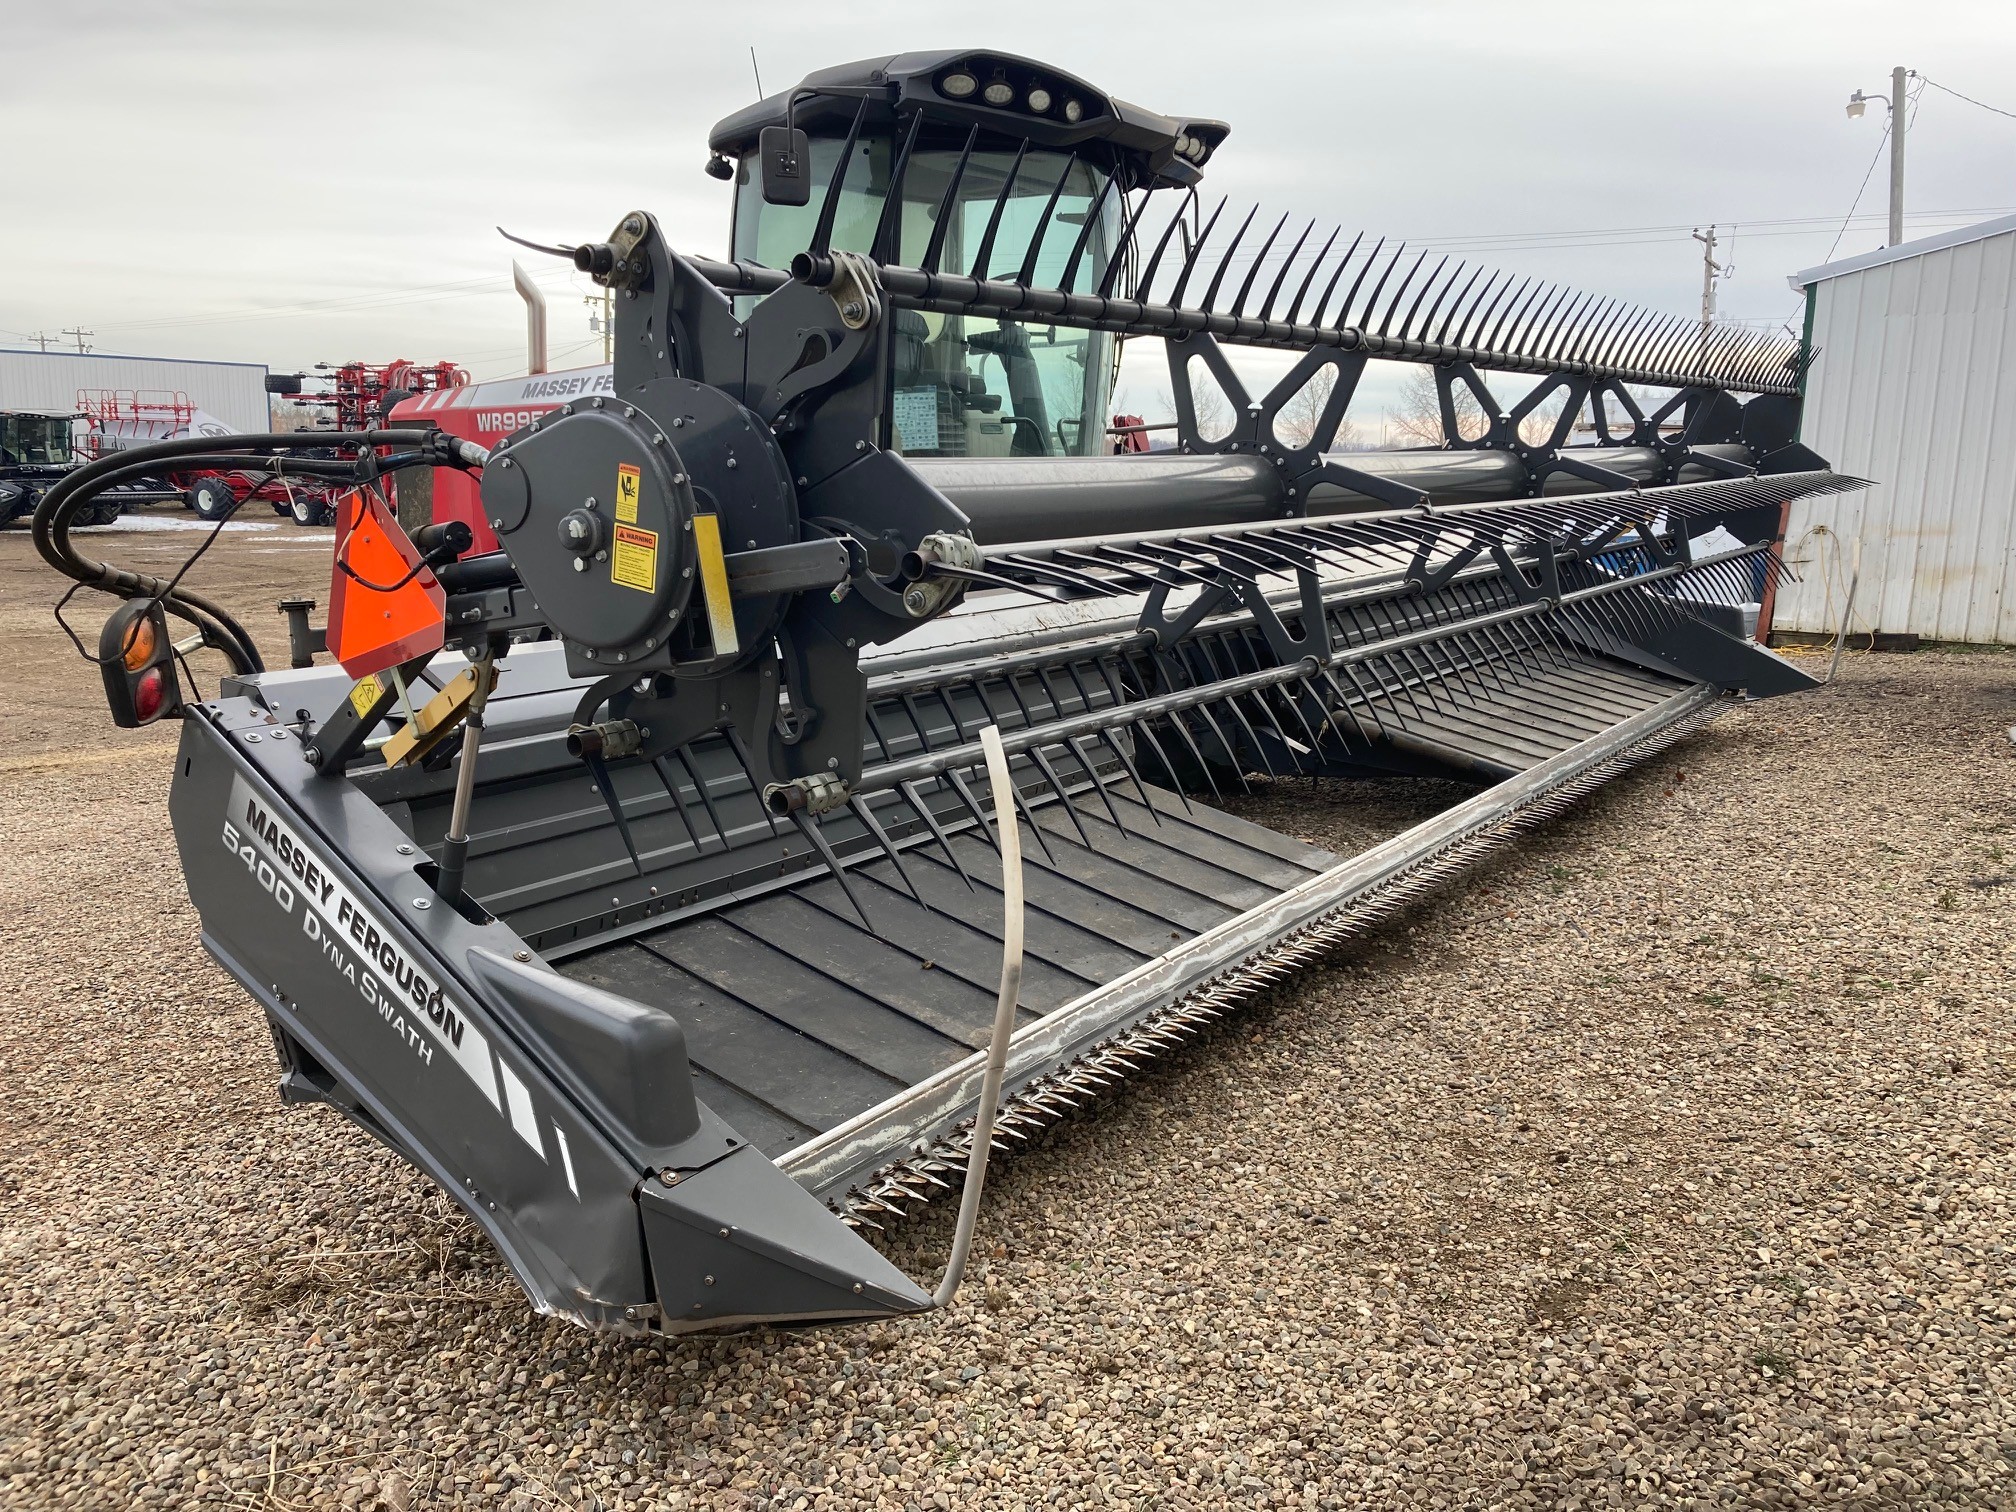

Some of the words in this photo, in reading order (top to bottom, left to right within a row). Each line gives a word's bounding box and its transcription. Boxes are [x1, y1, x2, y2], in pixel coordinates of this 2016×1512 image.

[521, 376, 591, 399] MASSEY
[626, 532, 653, 545] WARNING
[221, 820, 295, 915] 5400
[246, 799, 334, 905] MASSEY
[337, 896, 464, 1050] FERGUSON
